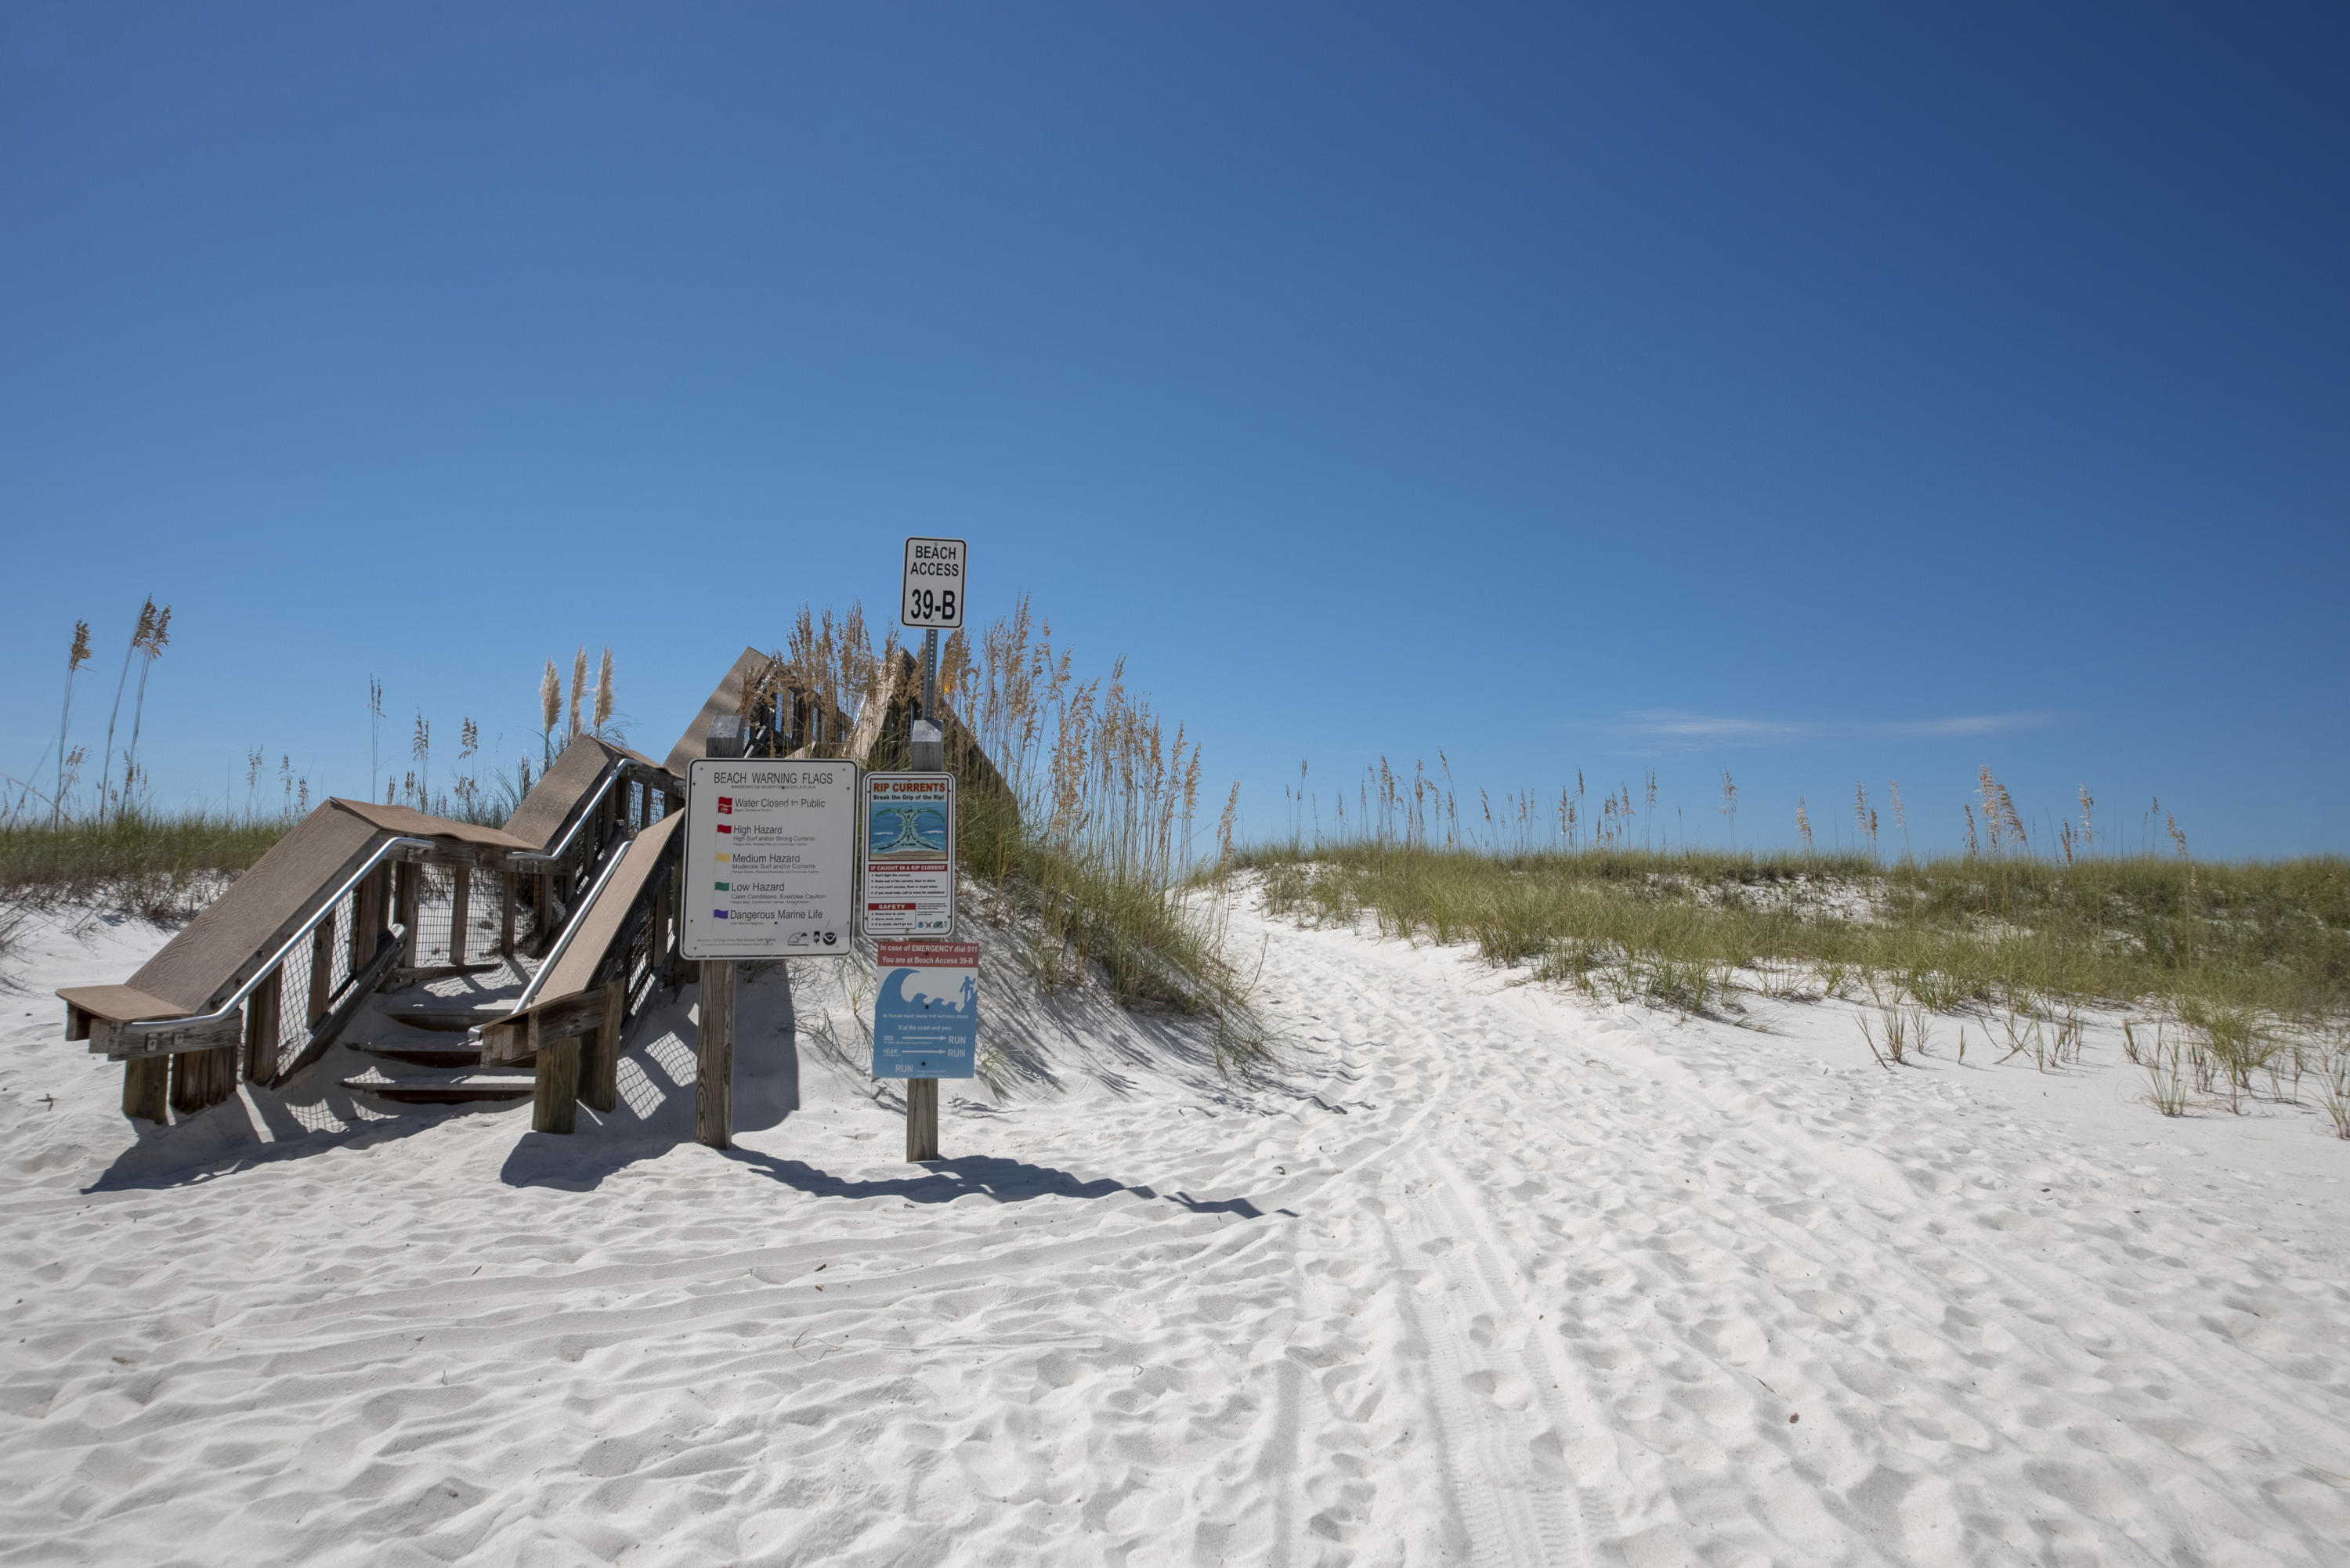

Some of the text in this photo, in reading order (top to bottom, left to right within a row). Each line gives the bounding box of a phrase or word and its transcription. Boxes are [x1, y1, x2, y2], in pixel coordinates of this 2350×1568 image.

[915, 545, 956, 560] BEACH
[910, 562, 959, 576] ACCESS
[911, 589, 955, 620] 39-B
[714, 772, 833, 784] BEACH WARNING FLAGS
[874, 783, 945, 792] RIP CURRENTS
[735, 798, 758, 807] Water
[761, 798, 788, 807] Closed
[801, 798, 825, 807] Public
[734, 825, 783, 836] High Hazard
[733, 854, 800, 862] Medium Hazard
[732, 883, 785, 891] Low Hazard
[730, 910, 823, 921] Dangerous Marine Life
[948, 1036, 966, 1044] RUN
[947, 1049, 965, 1058] RUN
